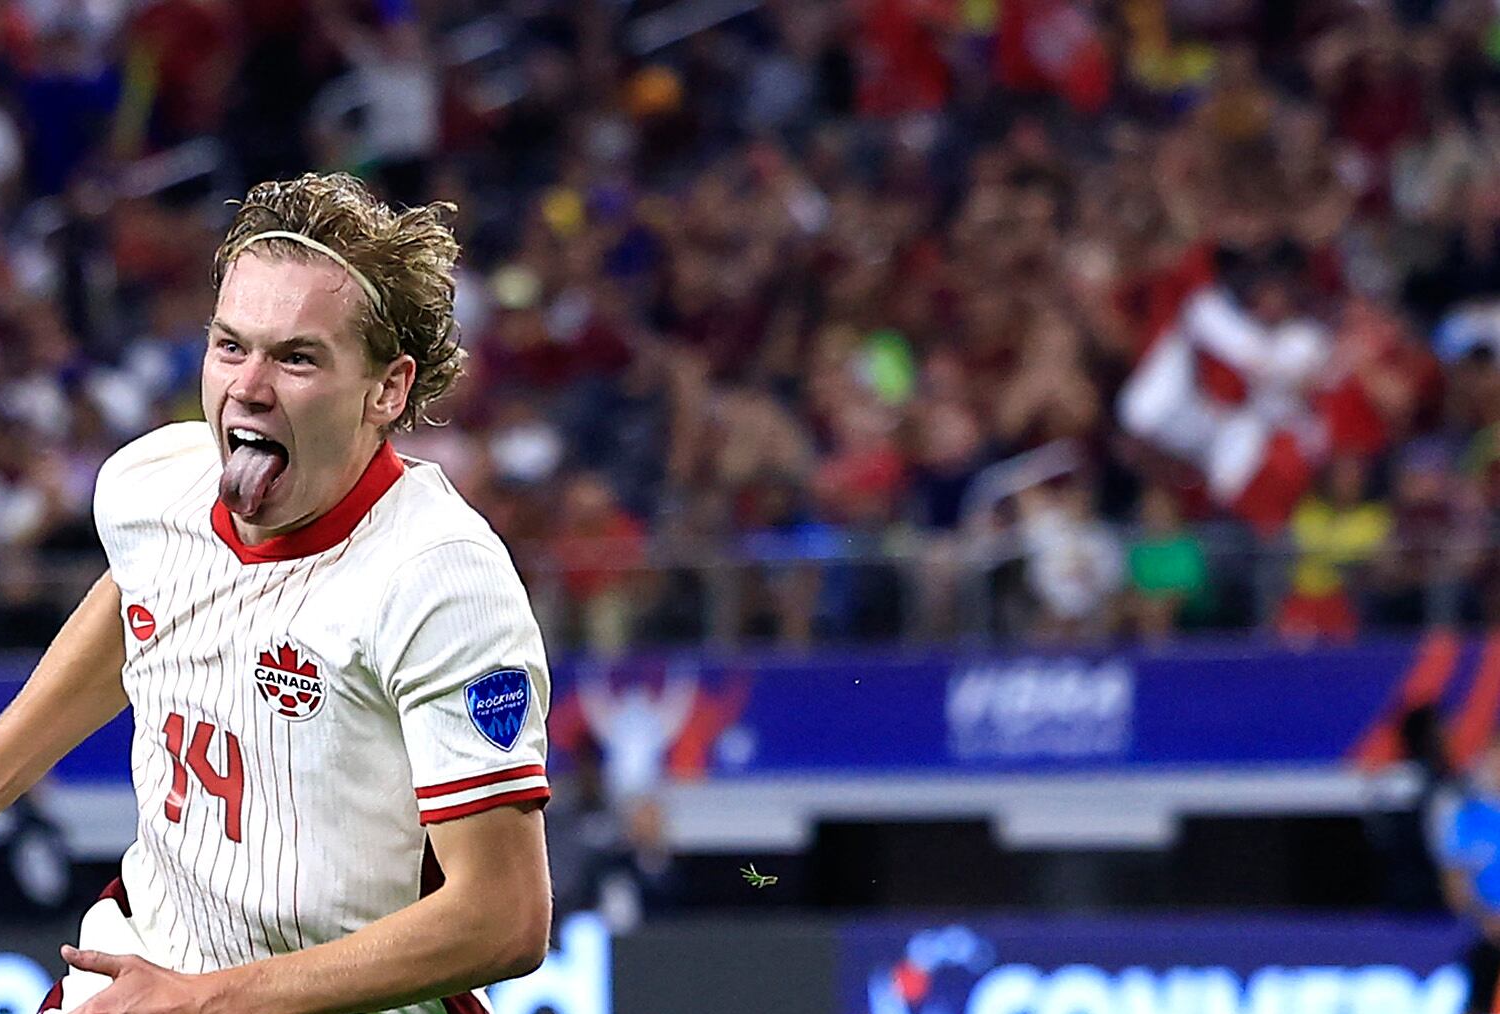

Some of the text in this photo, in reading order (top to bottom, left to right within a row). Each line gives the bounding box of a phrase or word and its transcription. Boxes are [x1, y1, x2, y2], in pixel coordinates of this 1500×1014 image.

[254, 668, 322, 694] CANADA
[476, 688, 525, 710] ROCKING
[161, 712, 245, 844] 14
